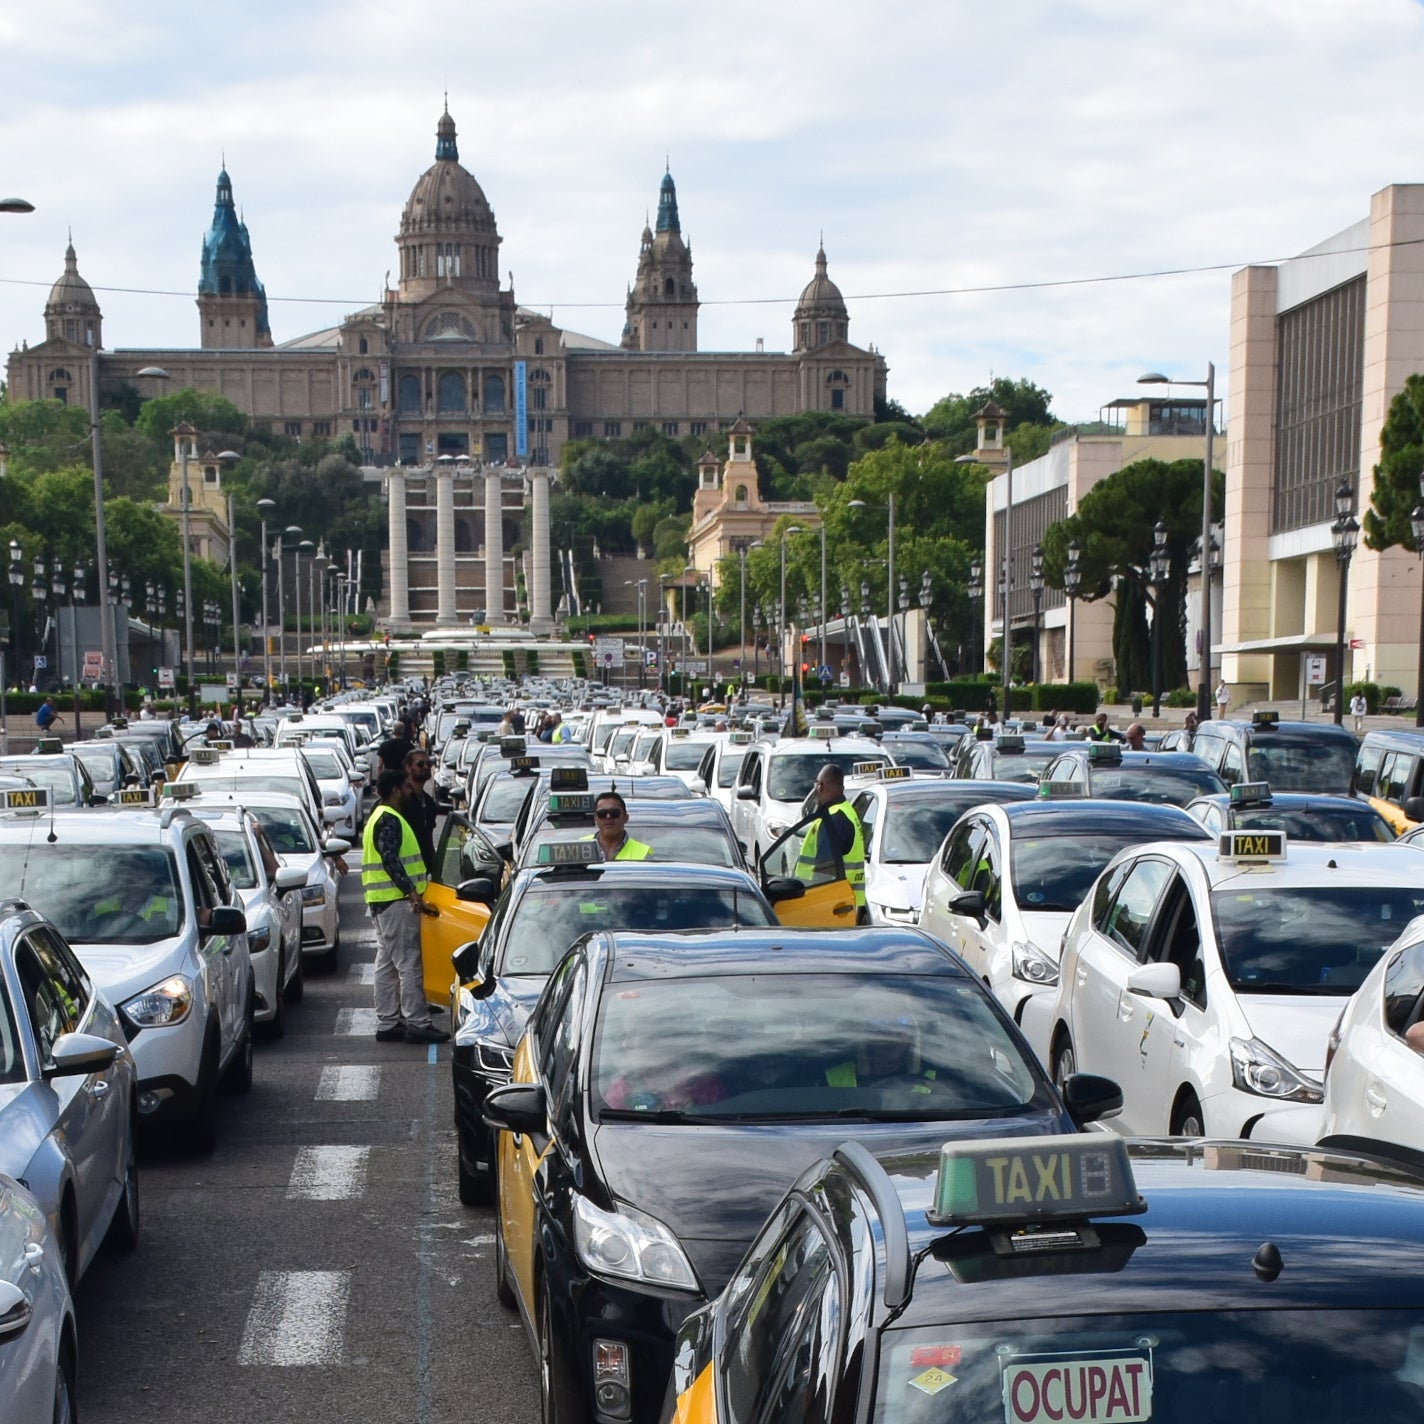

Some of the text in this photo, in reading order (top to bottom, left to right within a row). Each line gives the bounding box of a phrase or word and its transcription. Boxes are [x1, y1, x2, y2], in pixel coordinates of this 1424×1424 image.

[885, 768, 904, 777] TAXI
[7, 791, 37, 807] TAXI
[121, 791, 142, 803] TAXI
[560, 796, 581, 807] TAXI
[552, 844, 580, 858] TAXI
[1235, 835, 1270, 855] TAXI
[986, 1153, 1073, 1204] TAXI
[925, 1372, 943, 1384] 24
[1010, 1364, 1144, 1423] OCUPAT
